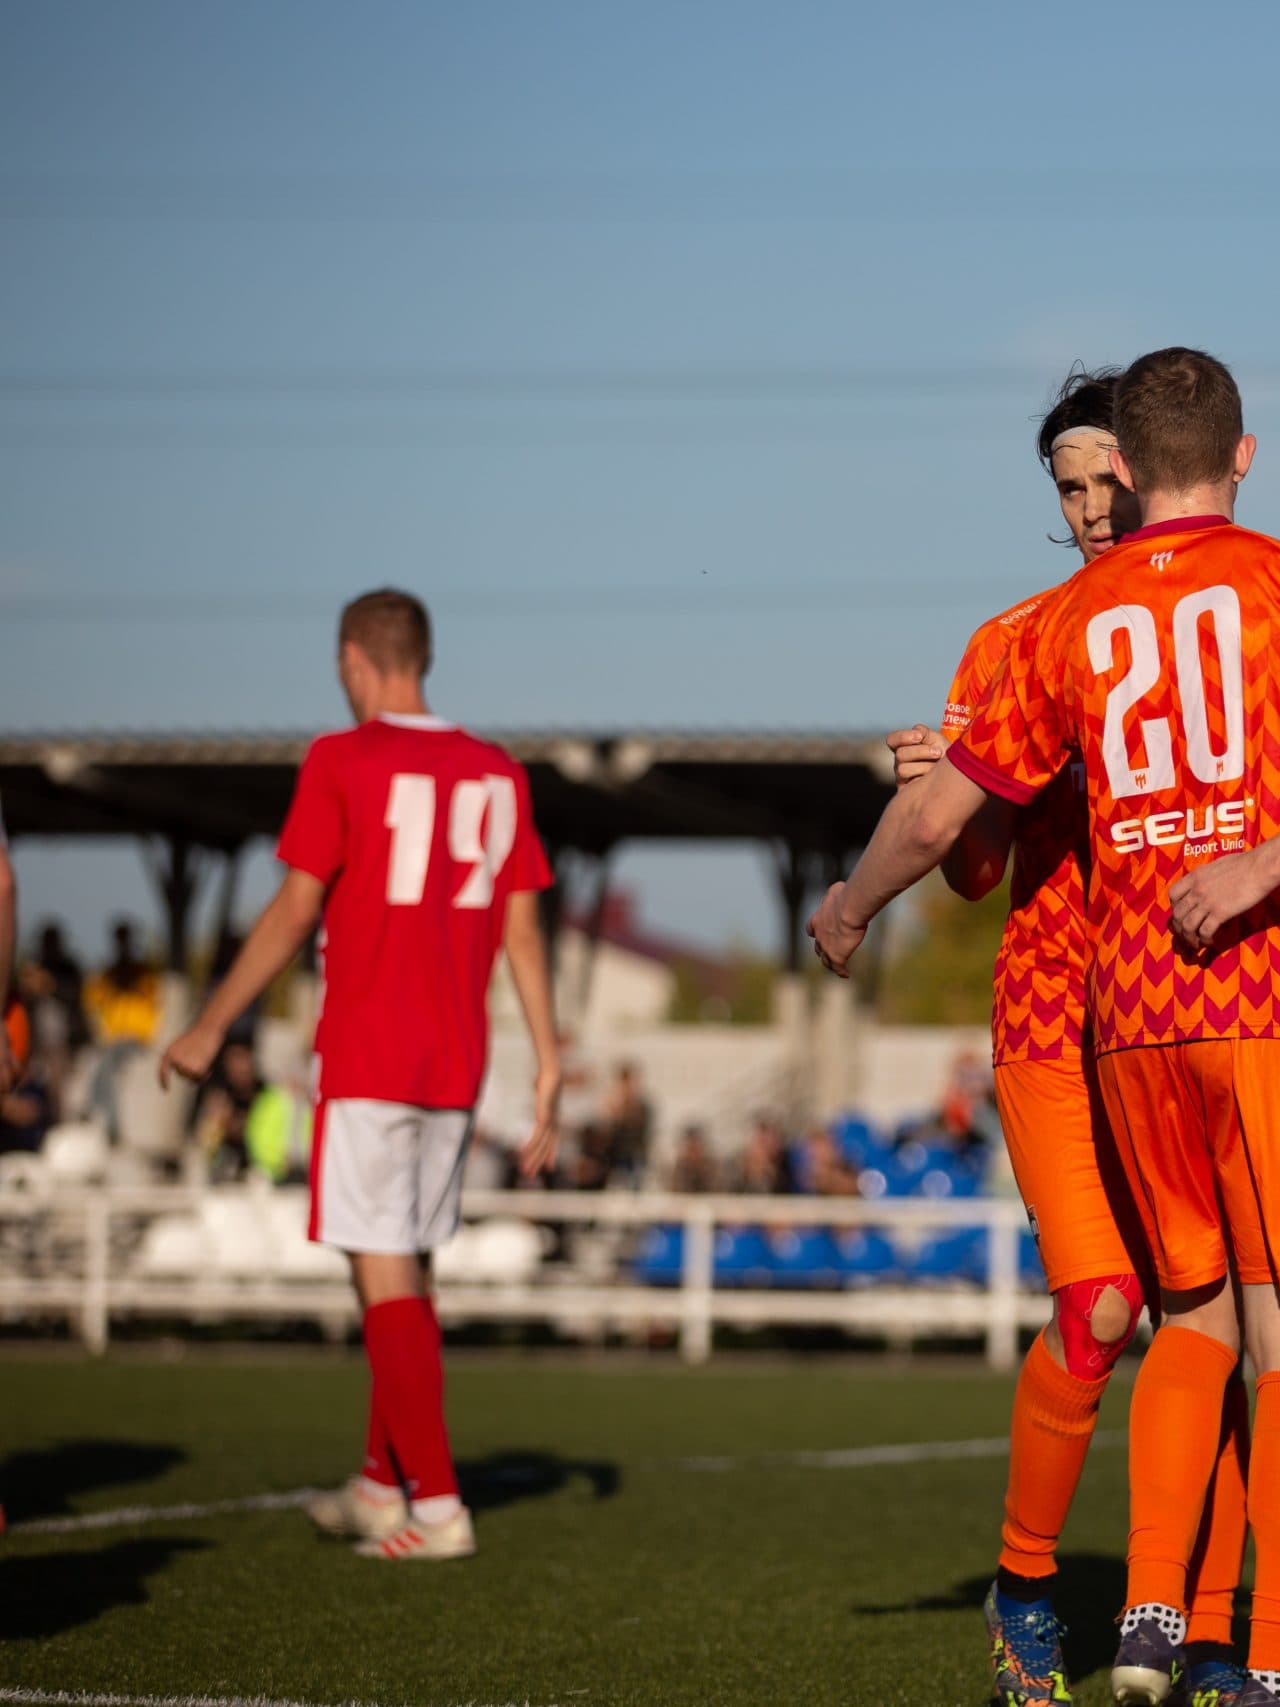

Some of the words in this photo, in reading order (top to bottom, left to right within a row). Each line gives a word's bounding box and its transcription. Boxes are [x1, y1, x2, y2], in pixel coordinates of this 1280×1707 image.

[1086, 585, 1245, 799] 20
[384, 773, 518, 909] 19
[1110, 800, 1245, 854] SEUS
[1184, 841, 1218, 857] Export
[1221, 837, 1245, 851] Unio
